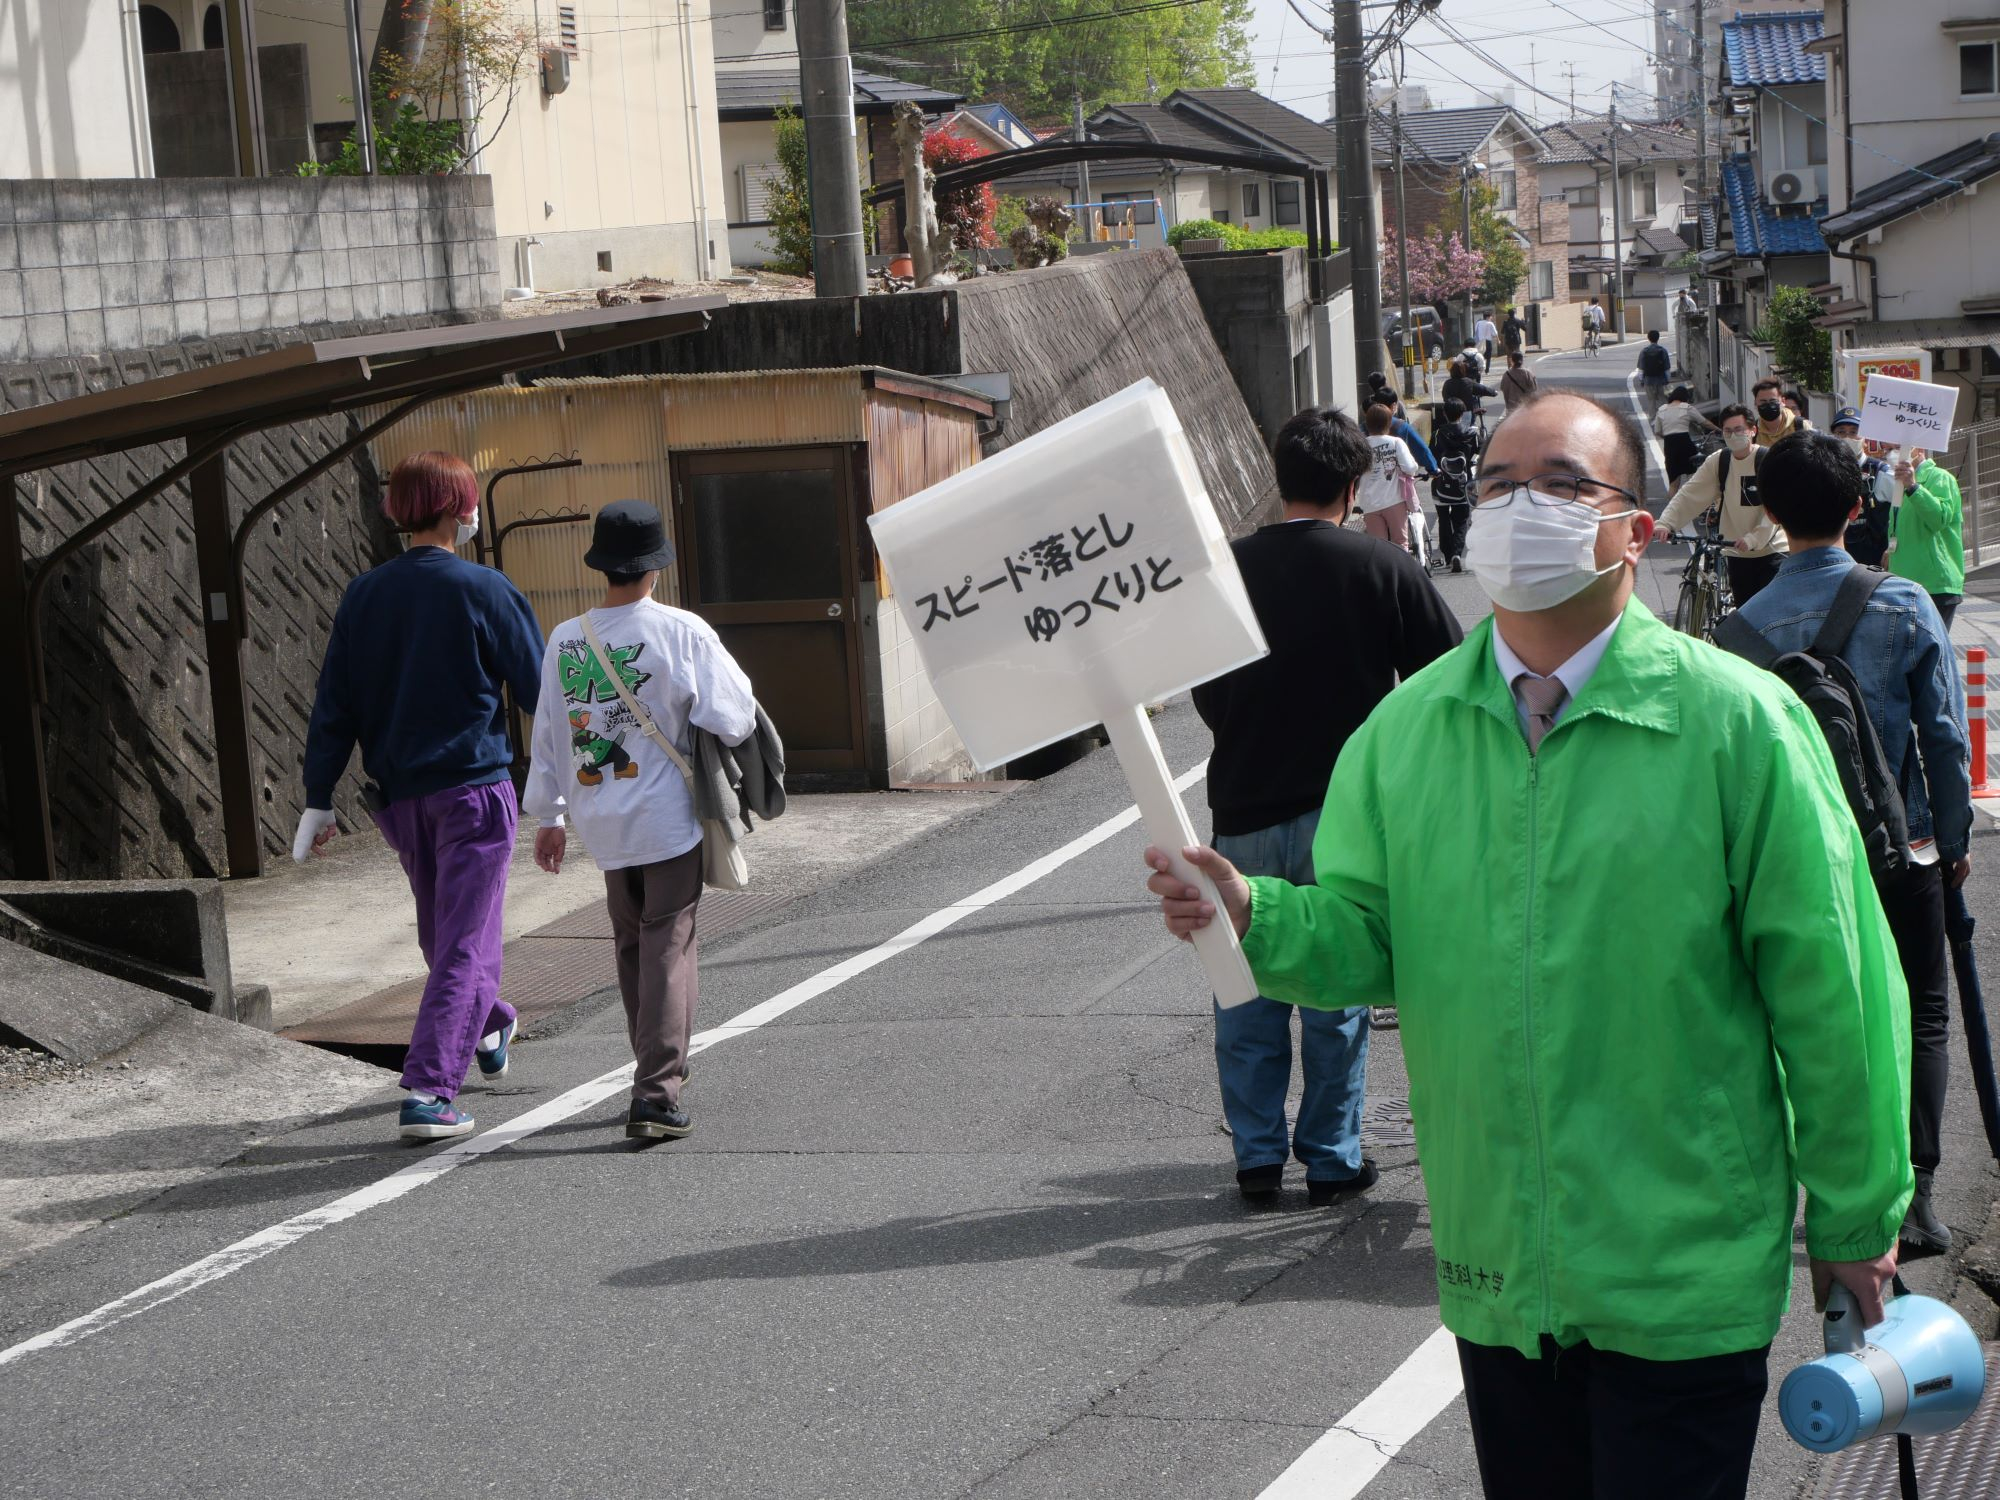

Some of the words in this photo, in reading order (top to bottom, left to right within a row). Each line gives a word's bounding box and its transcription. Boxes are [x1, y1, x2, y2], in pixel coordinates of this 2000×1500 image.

[1868, 396, 1937, 416] スピード落とし
[1896, 415, 1940, 430] ゆっくりと
[915, 513, 1134, 633] スピード落とし
[1024, 556, 1183, 642] ゆっくりと
